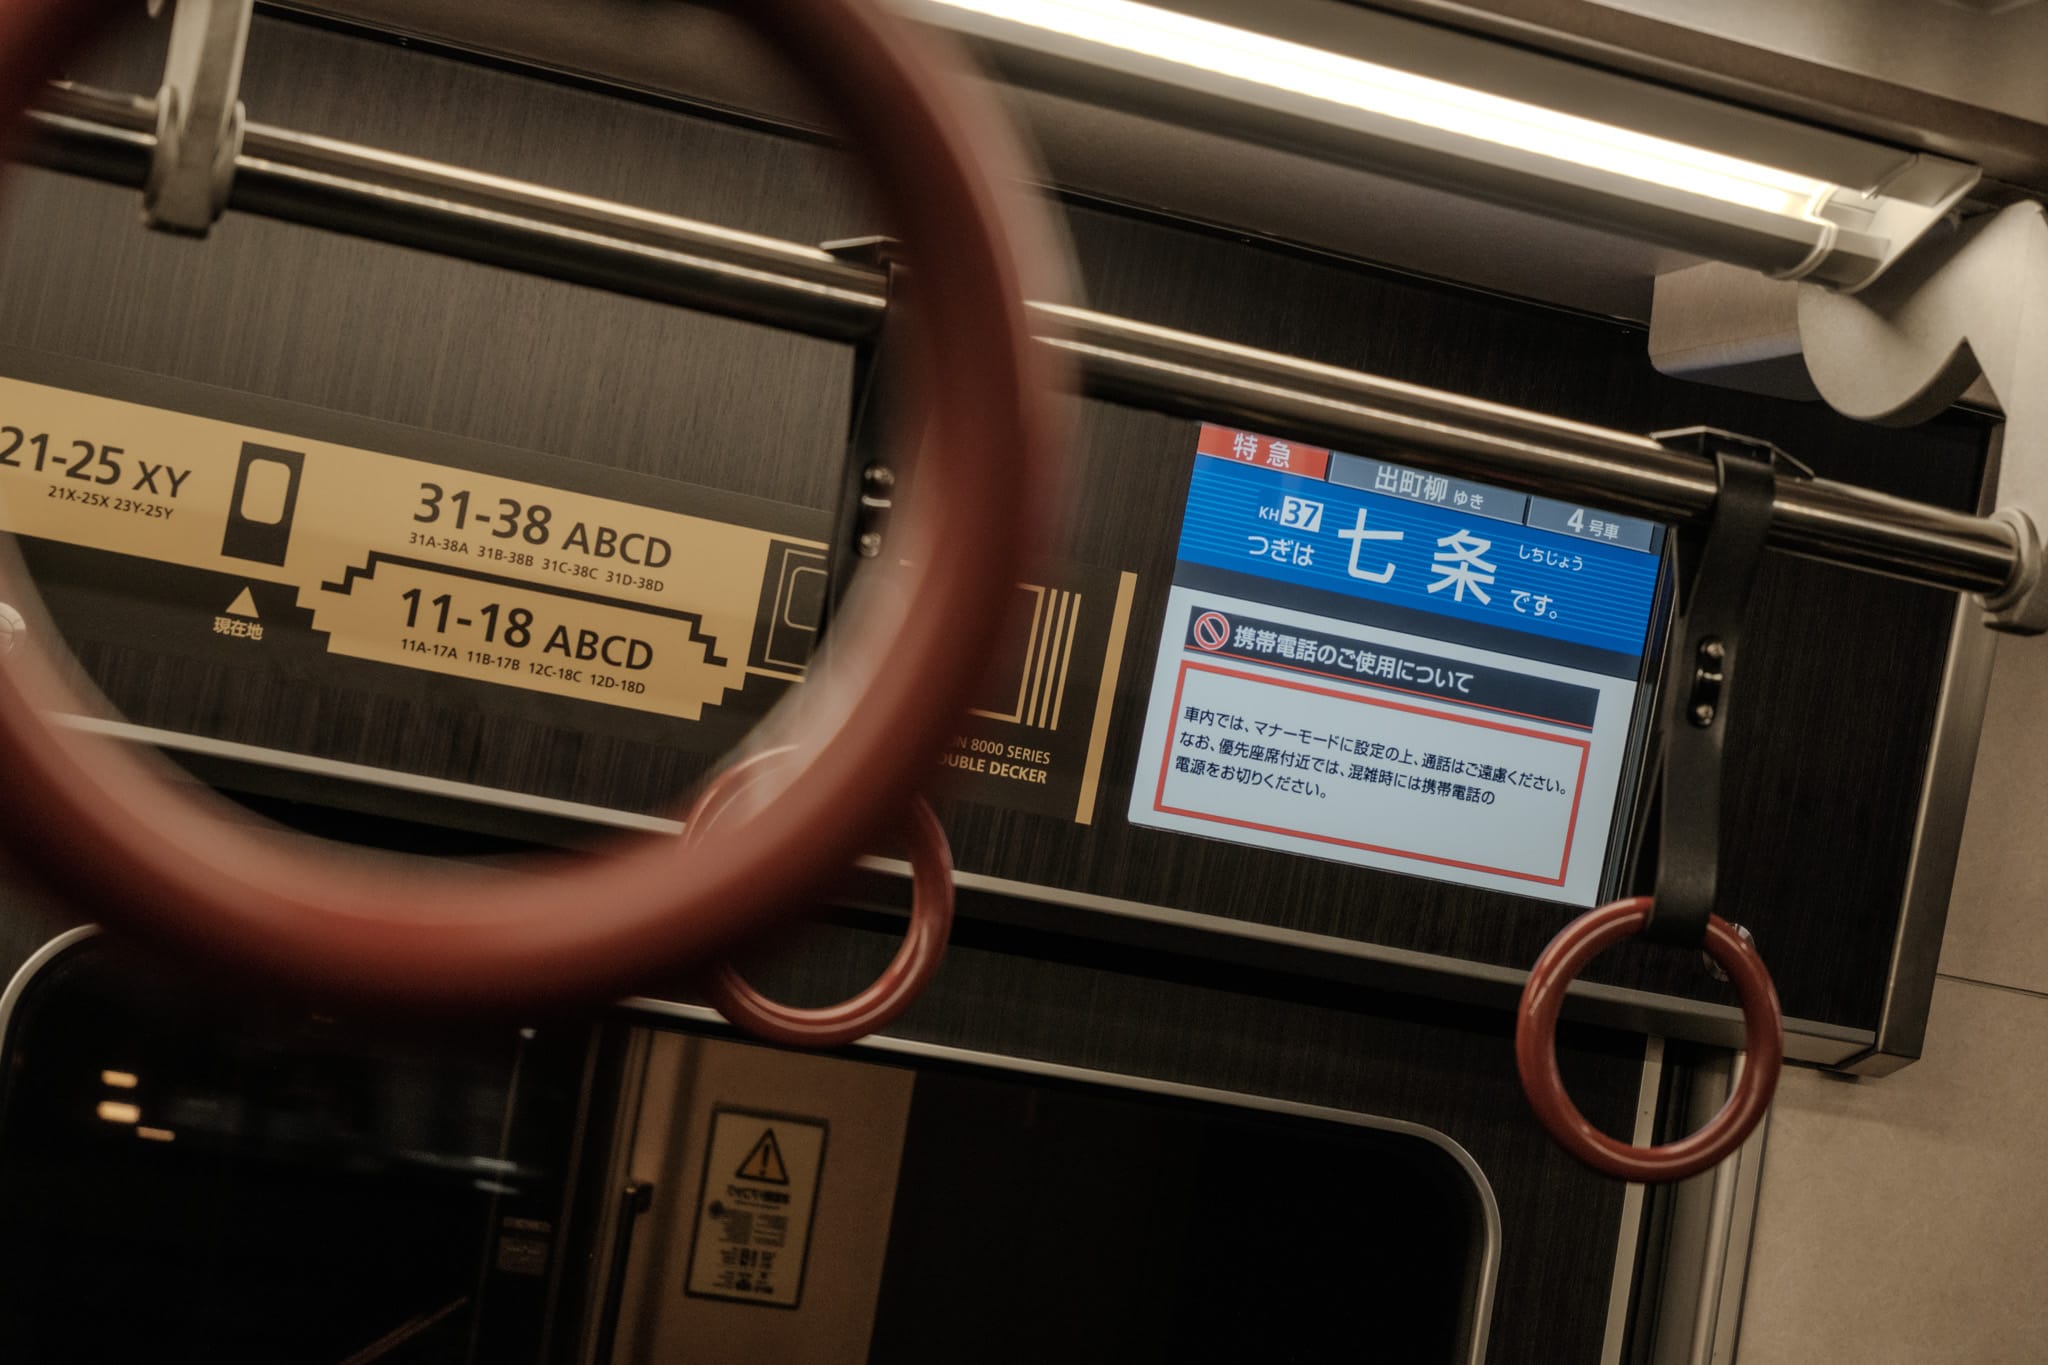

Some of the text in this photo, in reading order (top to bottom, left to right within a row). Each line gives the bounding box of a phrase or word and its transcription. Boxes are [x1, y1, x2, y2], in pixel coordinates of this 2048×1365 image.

[0, 425, 191, 498] 21-25 XY
[1233, 432, 1291, 469] 特急
[48, 485, 174, 520] 21X-25X 23Y-25Y
[413, 482, 672, 569] 31-38 ABCD
[408, 531, 665, 593] 31A-38A 31B-38B 31C-38C 31D-38D
[1248, 535, 1315, 566] つぎは
[1510, 589, 1558, 620] です。
[1518, 544, 1583, 572] しちじょう
[213, 616, 264, 641] 現在地
[401, 587, 653, 671] 11-18 ABCD
[400, 638, 646, 695] 11A-17A 11B-17B 12C-18C 12D-18D
[1234, 625, 1475, 694] 携帯電話のご使用について
[970, 738, 1004, 756] 8000
[1007, 745, 1051, 766] SERIES
[989, 761, 1048, 785] DECKER
[1175, 755, 1327, 800] 電源をお切りください。
